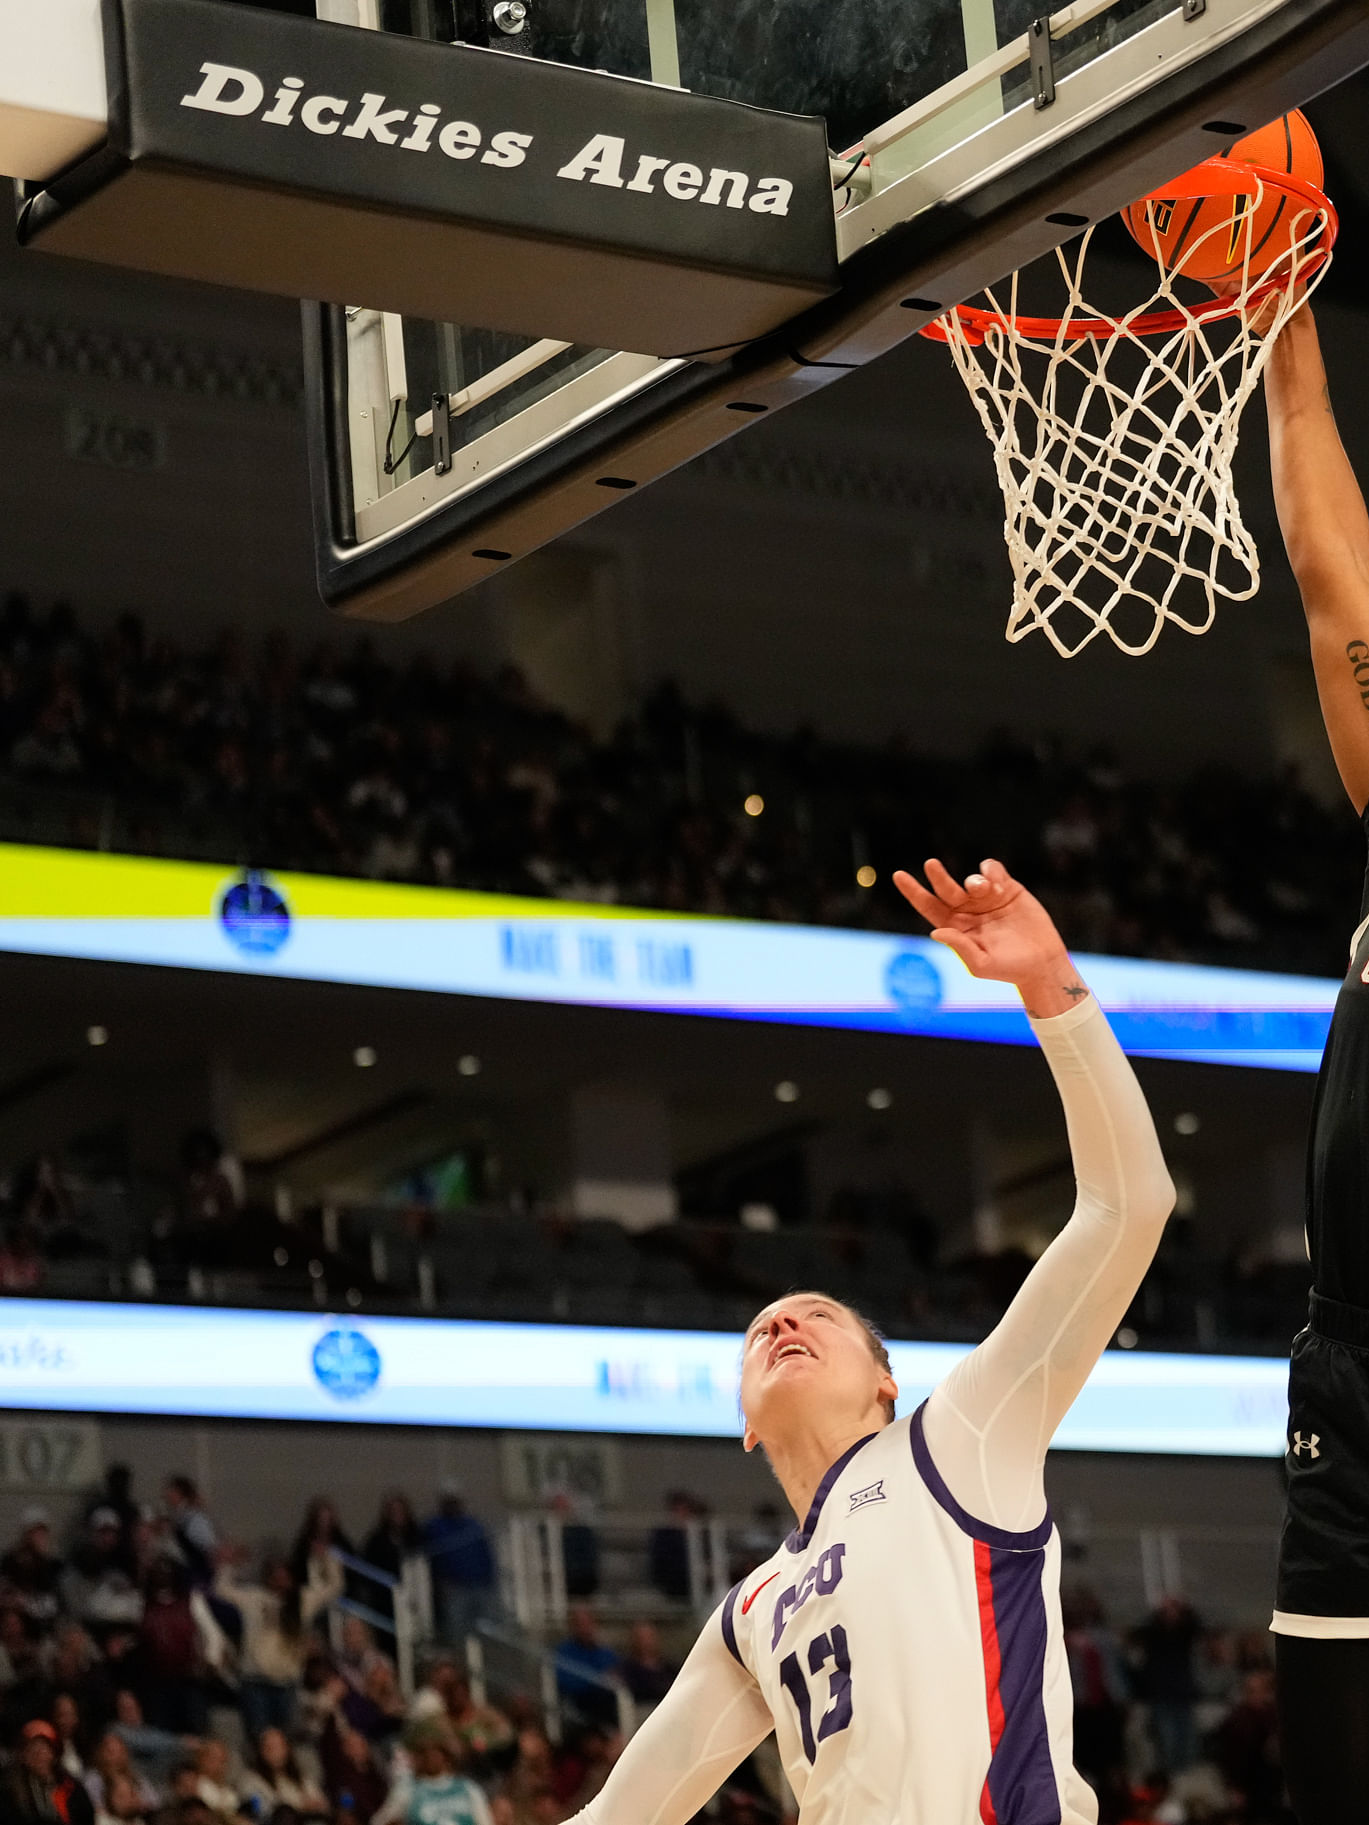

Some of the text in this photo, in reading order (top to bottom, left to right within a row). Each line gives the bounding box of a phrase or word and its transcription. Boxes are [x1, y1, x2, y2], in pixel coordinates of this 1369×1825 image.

[180, 62, 794, 216] Dickies Arena
[779, 1624, 853, 1767] 13
